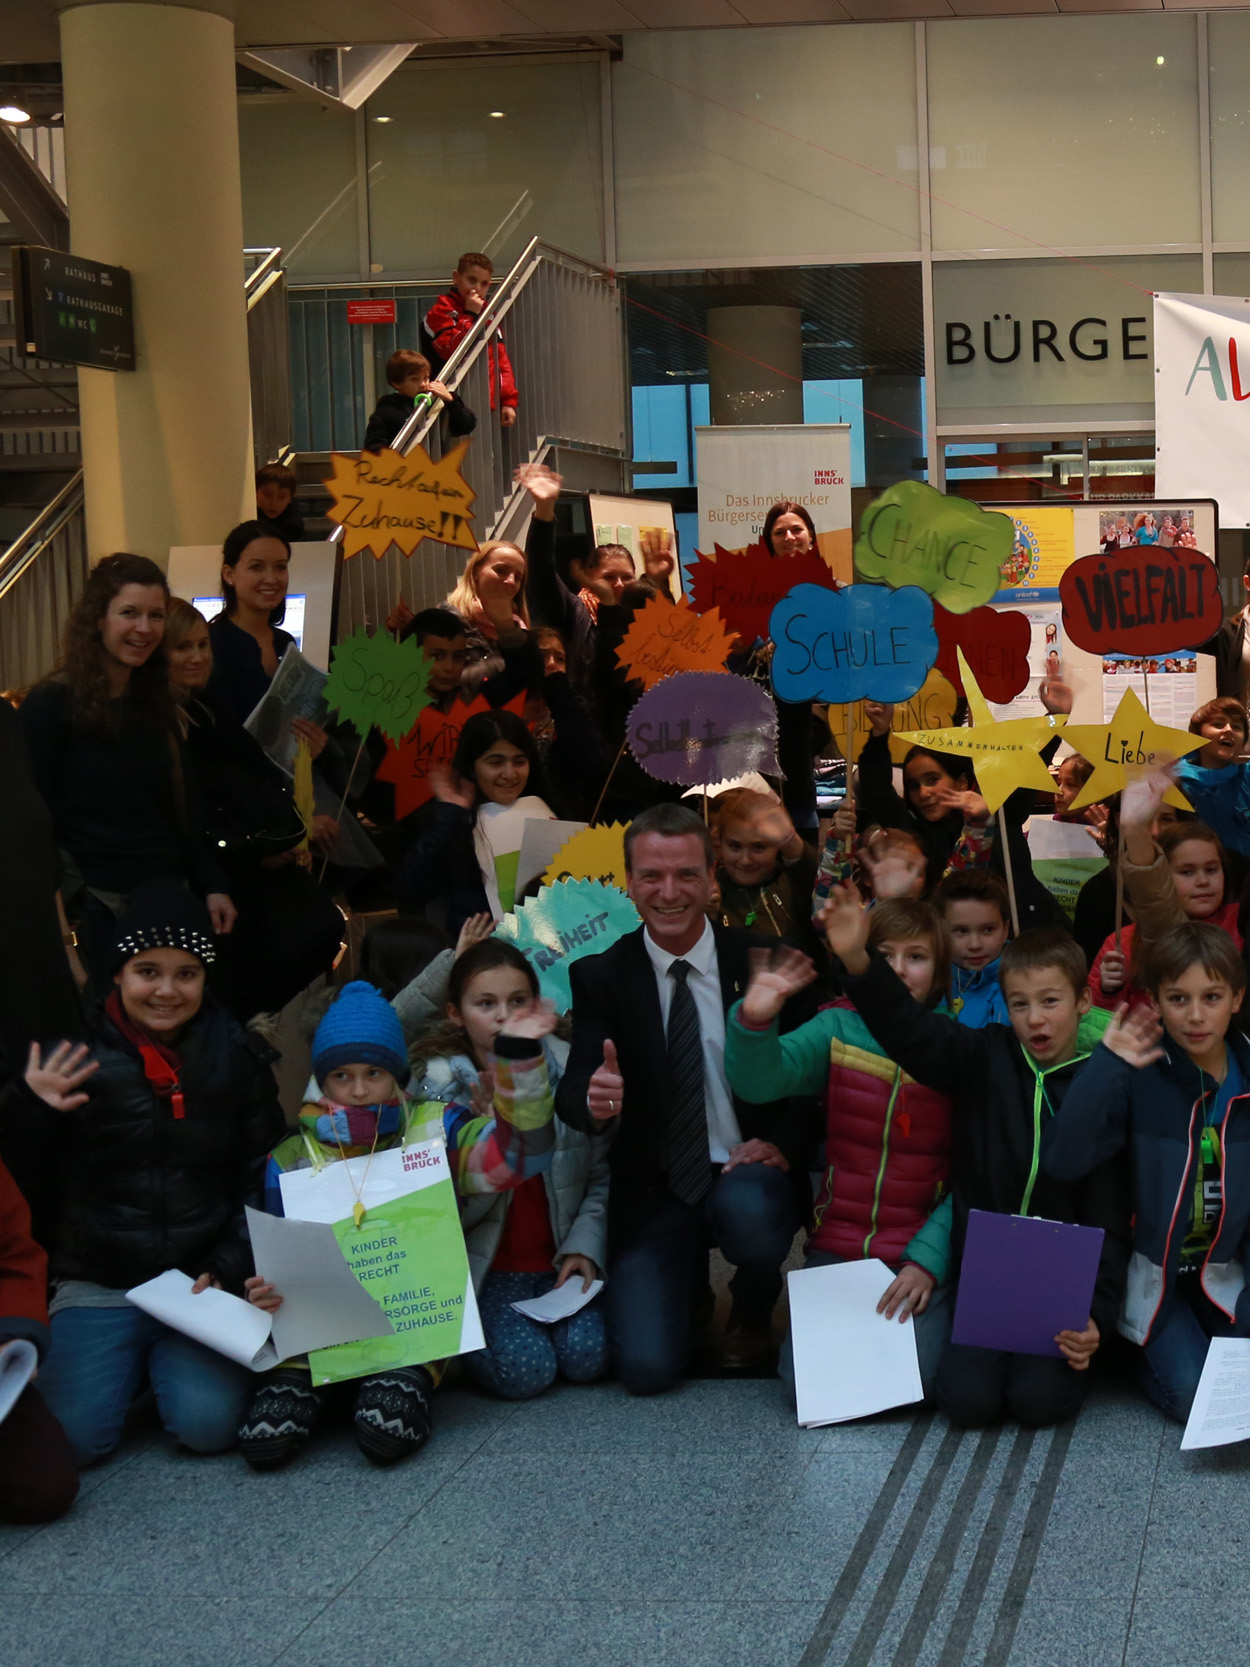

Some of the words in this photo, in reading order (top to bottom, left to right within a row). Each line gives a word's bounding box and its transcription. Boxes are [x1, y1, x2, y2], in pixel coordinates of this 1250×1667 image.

[65, 266, 97, 283] RATHAUS
[66, 295, 124, 317] RATHAUSGARAGE
[945, 313, 1148, 365] BÜRGE
[814, 477, 844, 485] BRUCK
[725, 494, 749, 507] Das
[753, 492, 830, 506] Innsbrucker
[868, 503, 988, 589] CHANCE
[785, 613, 912, 675] SCHULE
[343, 647, 421, 720] Spaß
[841, 692, 942, 734] BILUNG
[1104, 731, 1156, 765] Liebe
[1053, 876, 1081, 887] KINDER
[403, 1155, 442, 1172] BRUCK
[351, 1236, 398, 1255] KINDER
[347, 1255, 383, 1270] haben
[385, 1250, 407, 1261] das
[358, 1263, 400, 1282] RECHT
[383, 1286, 435, 1306] FAMILIE,
[440, 1294, 463, 1308] und
[395, 1311, 458, 1333] ZUHAUSE.
